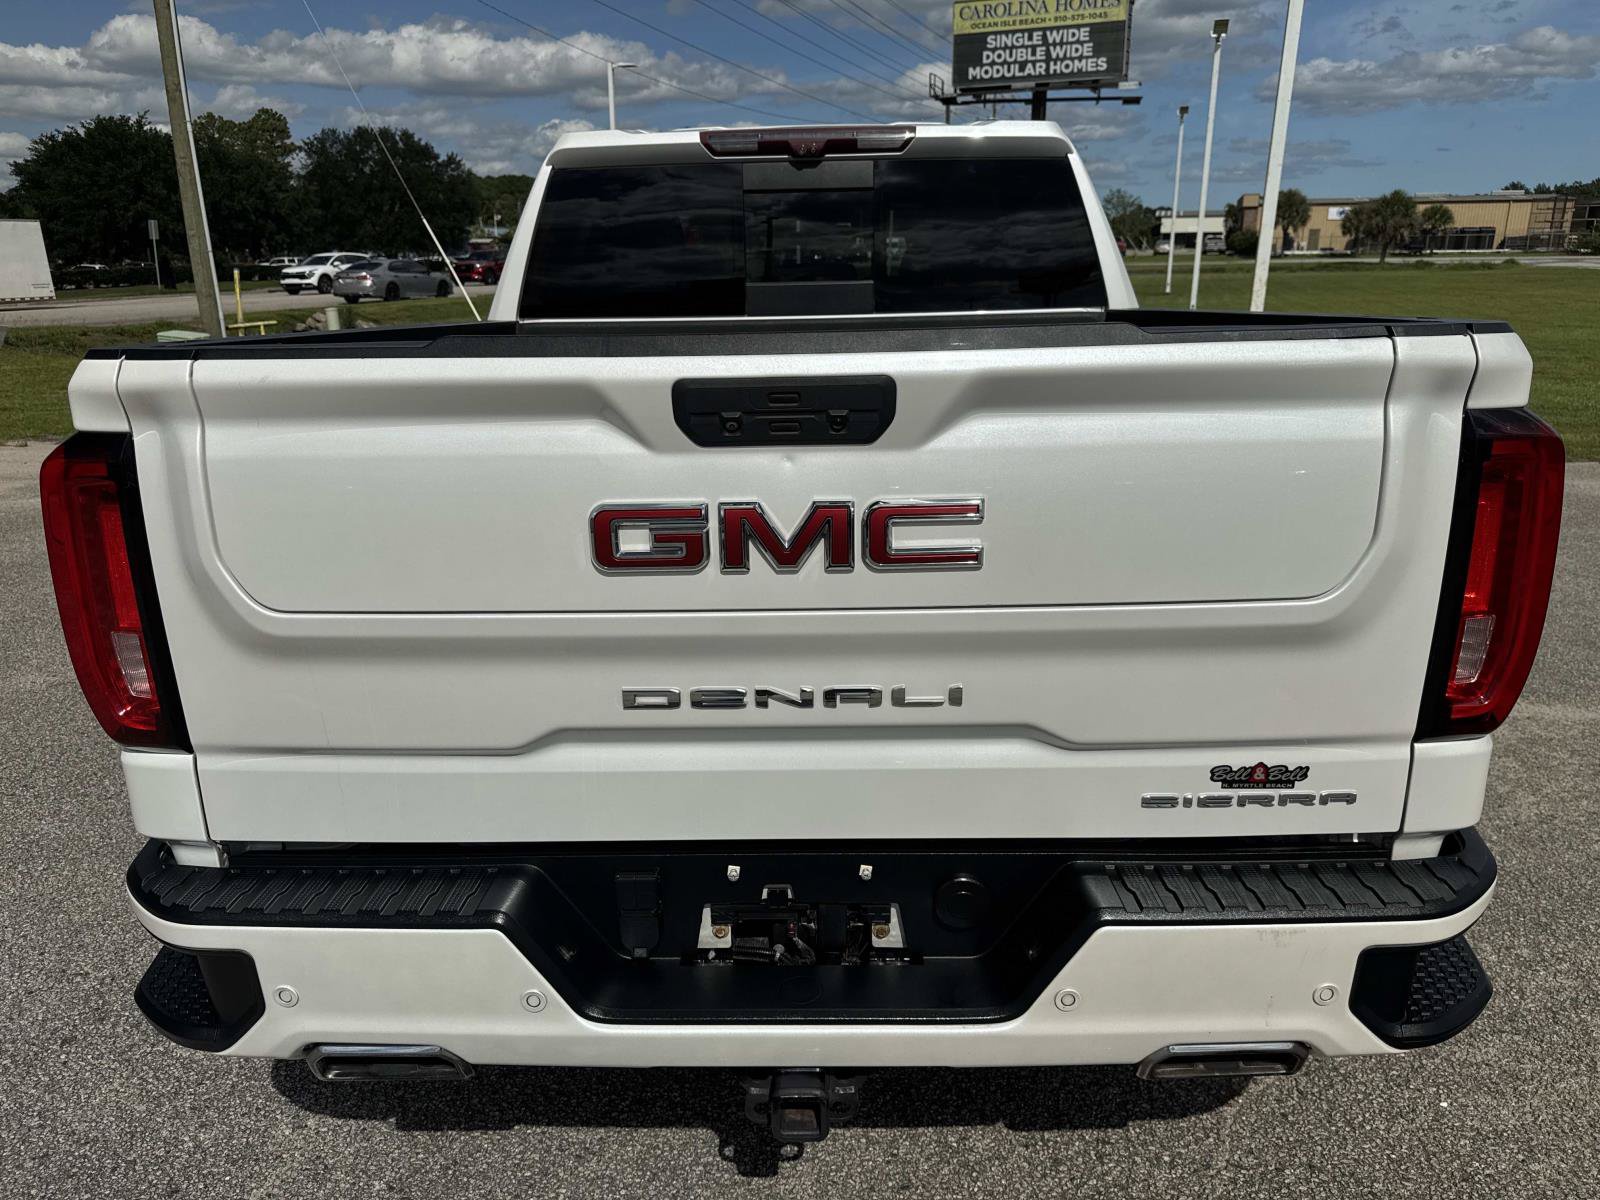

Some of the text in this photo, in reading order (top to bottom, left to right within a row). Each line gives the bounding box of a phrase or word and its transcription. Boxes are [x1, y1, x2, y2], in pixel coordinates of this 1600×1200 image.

[959, 0, 1120, 21] CAROLINA HOMES
[971, 20, 998, 29] OCEAN
[1000, 19, 1017, 27] ISLE
[1018, 17, 1047, 26] BEACH
[986, 27, 1090, 49] SINGLE WIDE
[982, 43, 1093, 64] DOUBLE WIDE
[968, 57, 1107, 80] MODULAR HOMES
[589, 497, 985, 575] GMC
[622, 684, 963, 711] DENALI
[1211, 765, 1308, 781] Bell & Bell
[1141, 789, 1358, 808] SIERRA
